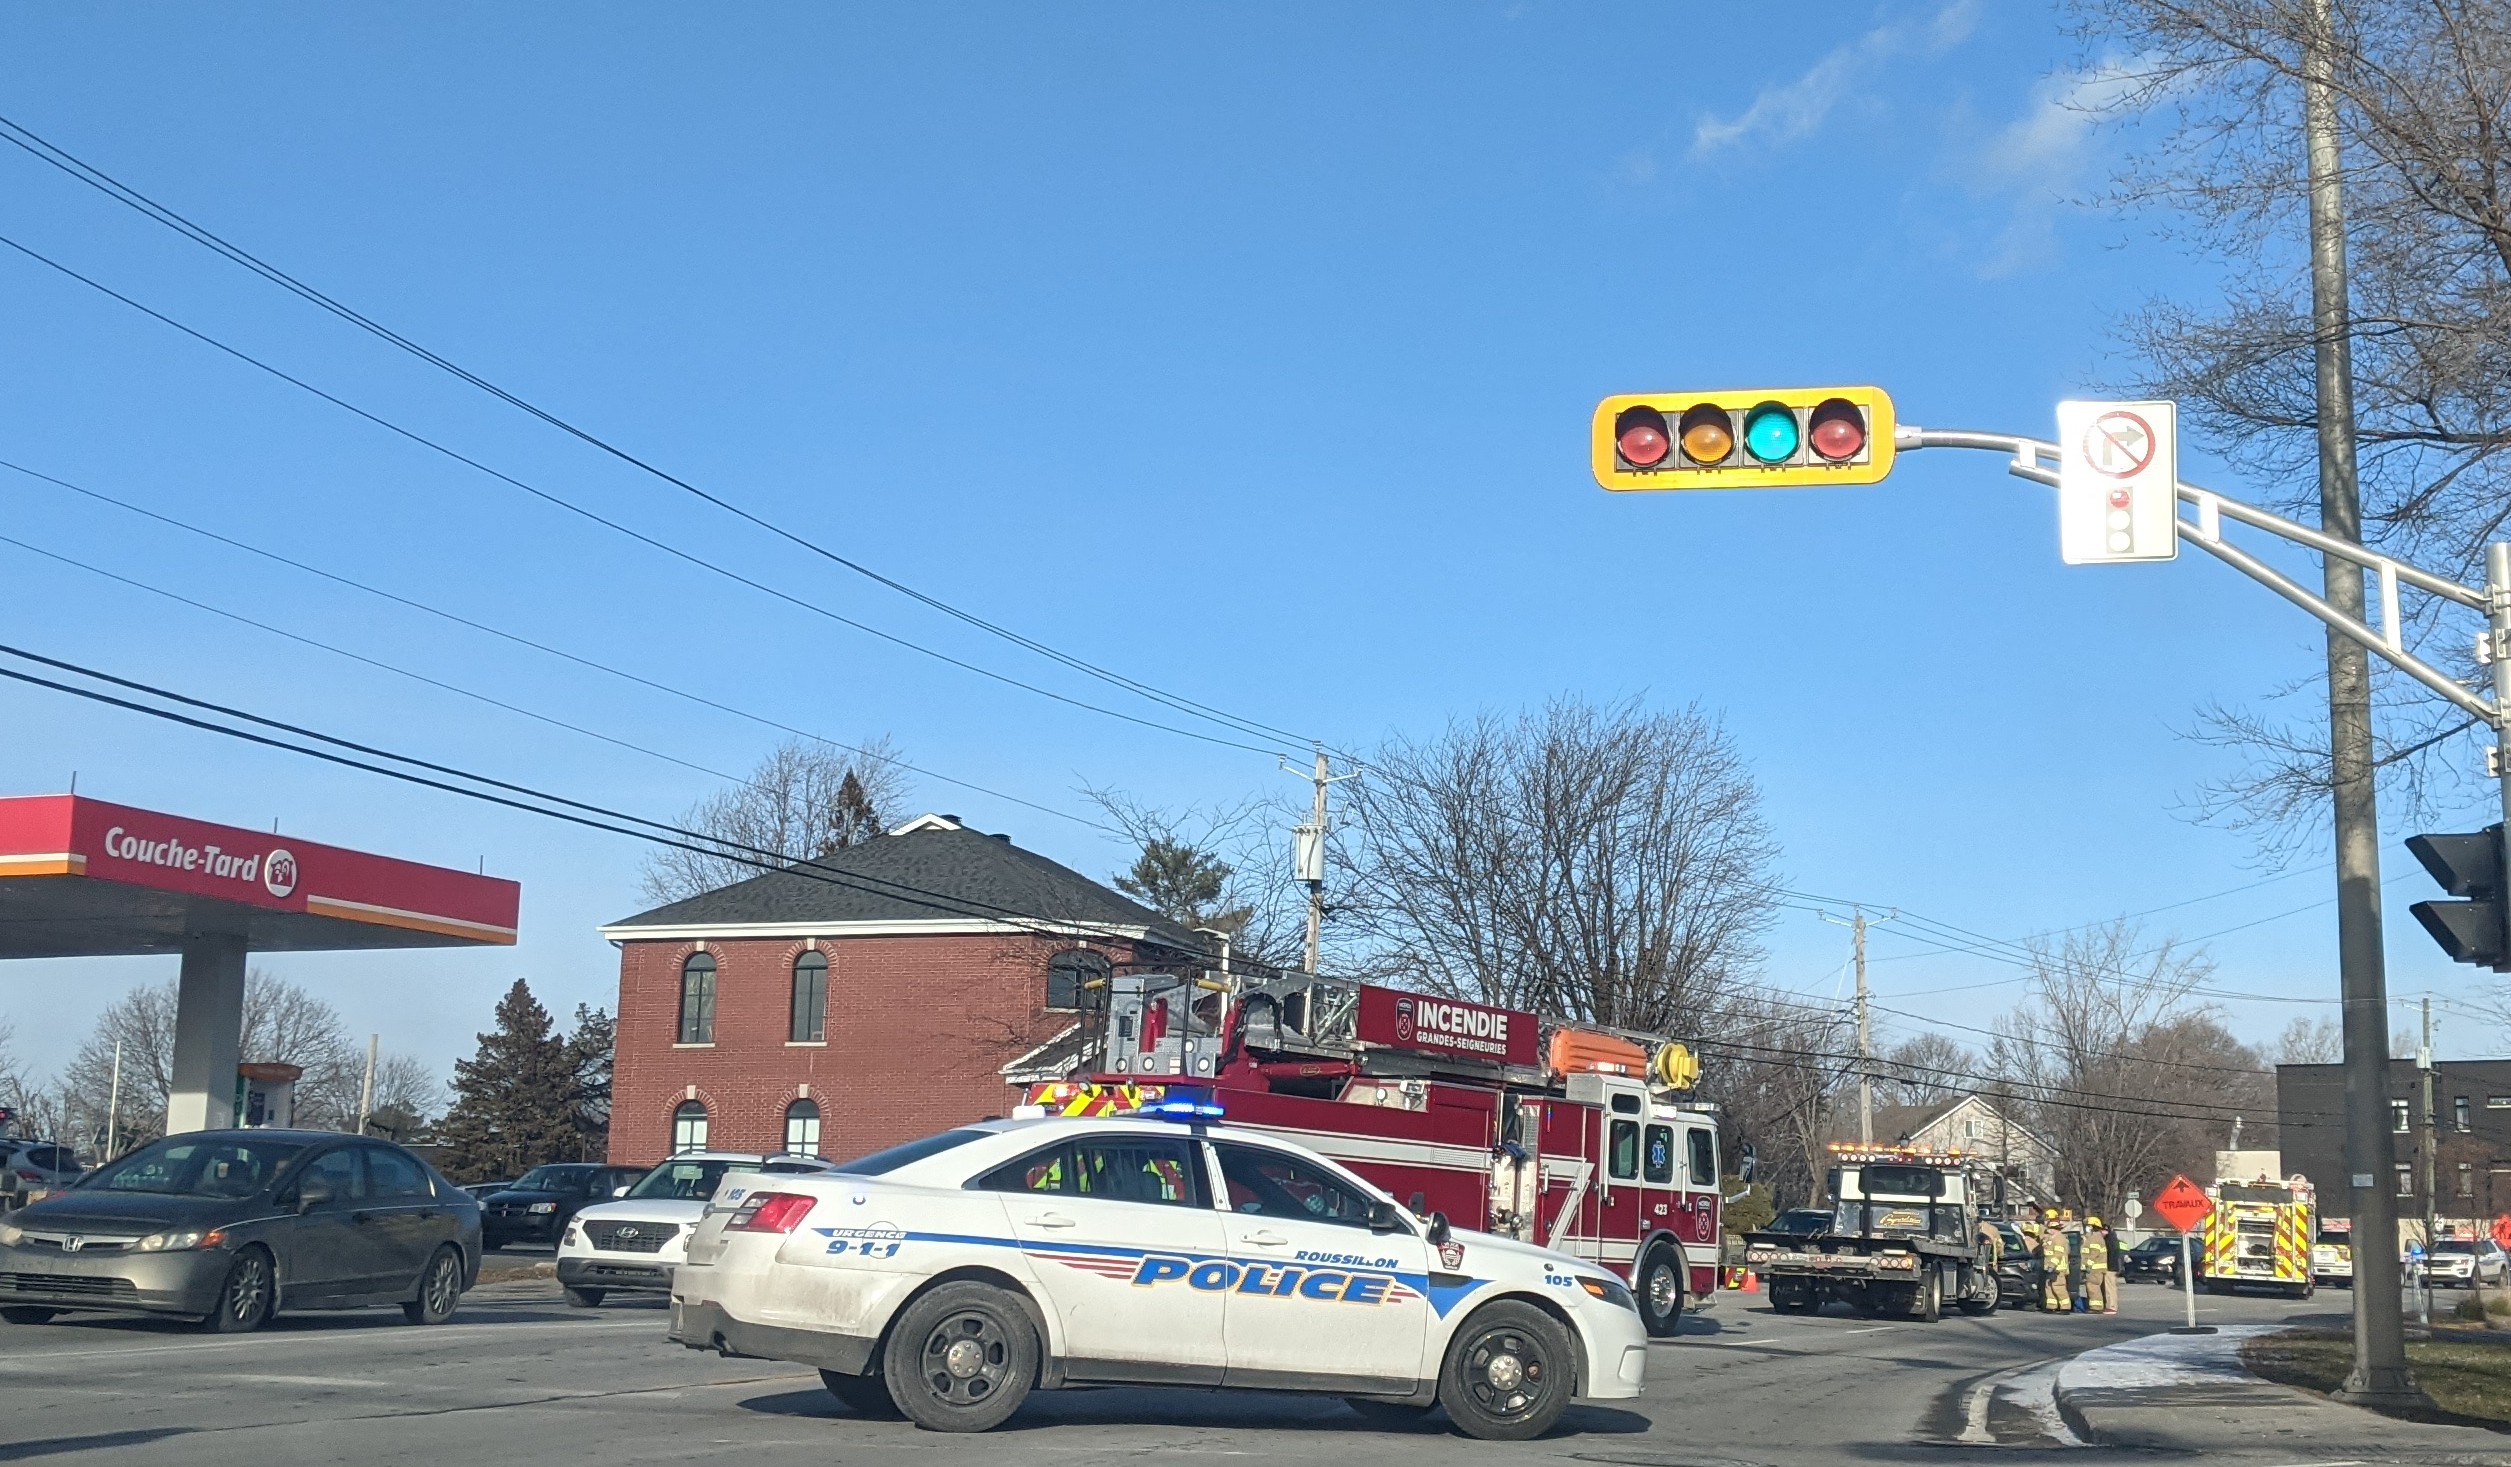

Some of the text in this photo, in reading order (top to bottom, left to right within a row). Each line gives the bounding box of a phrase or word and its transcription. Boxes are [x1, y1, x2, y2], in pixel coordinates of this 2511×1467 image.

[105, 826, 260, 881] Couche-Tard
[1417, 1000, 1508, 1041] INCENDIE
[1416, 1030, 1507, 1056] GRANDES-SEIGNEURIES
[1654, 1203, 1668, 1216] 423
[2162, 1199, 2205, 1210] TRAVAUX
[825, 1240, 901, 1258] 9-1-1
[1131, 1254, 1395, 1306] POLICE
[1545, 1275, 1573, 1287] 105
